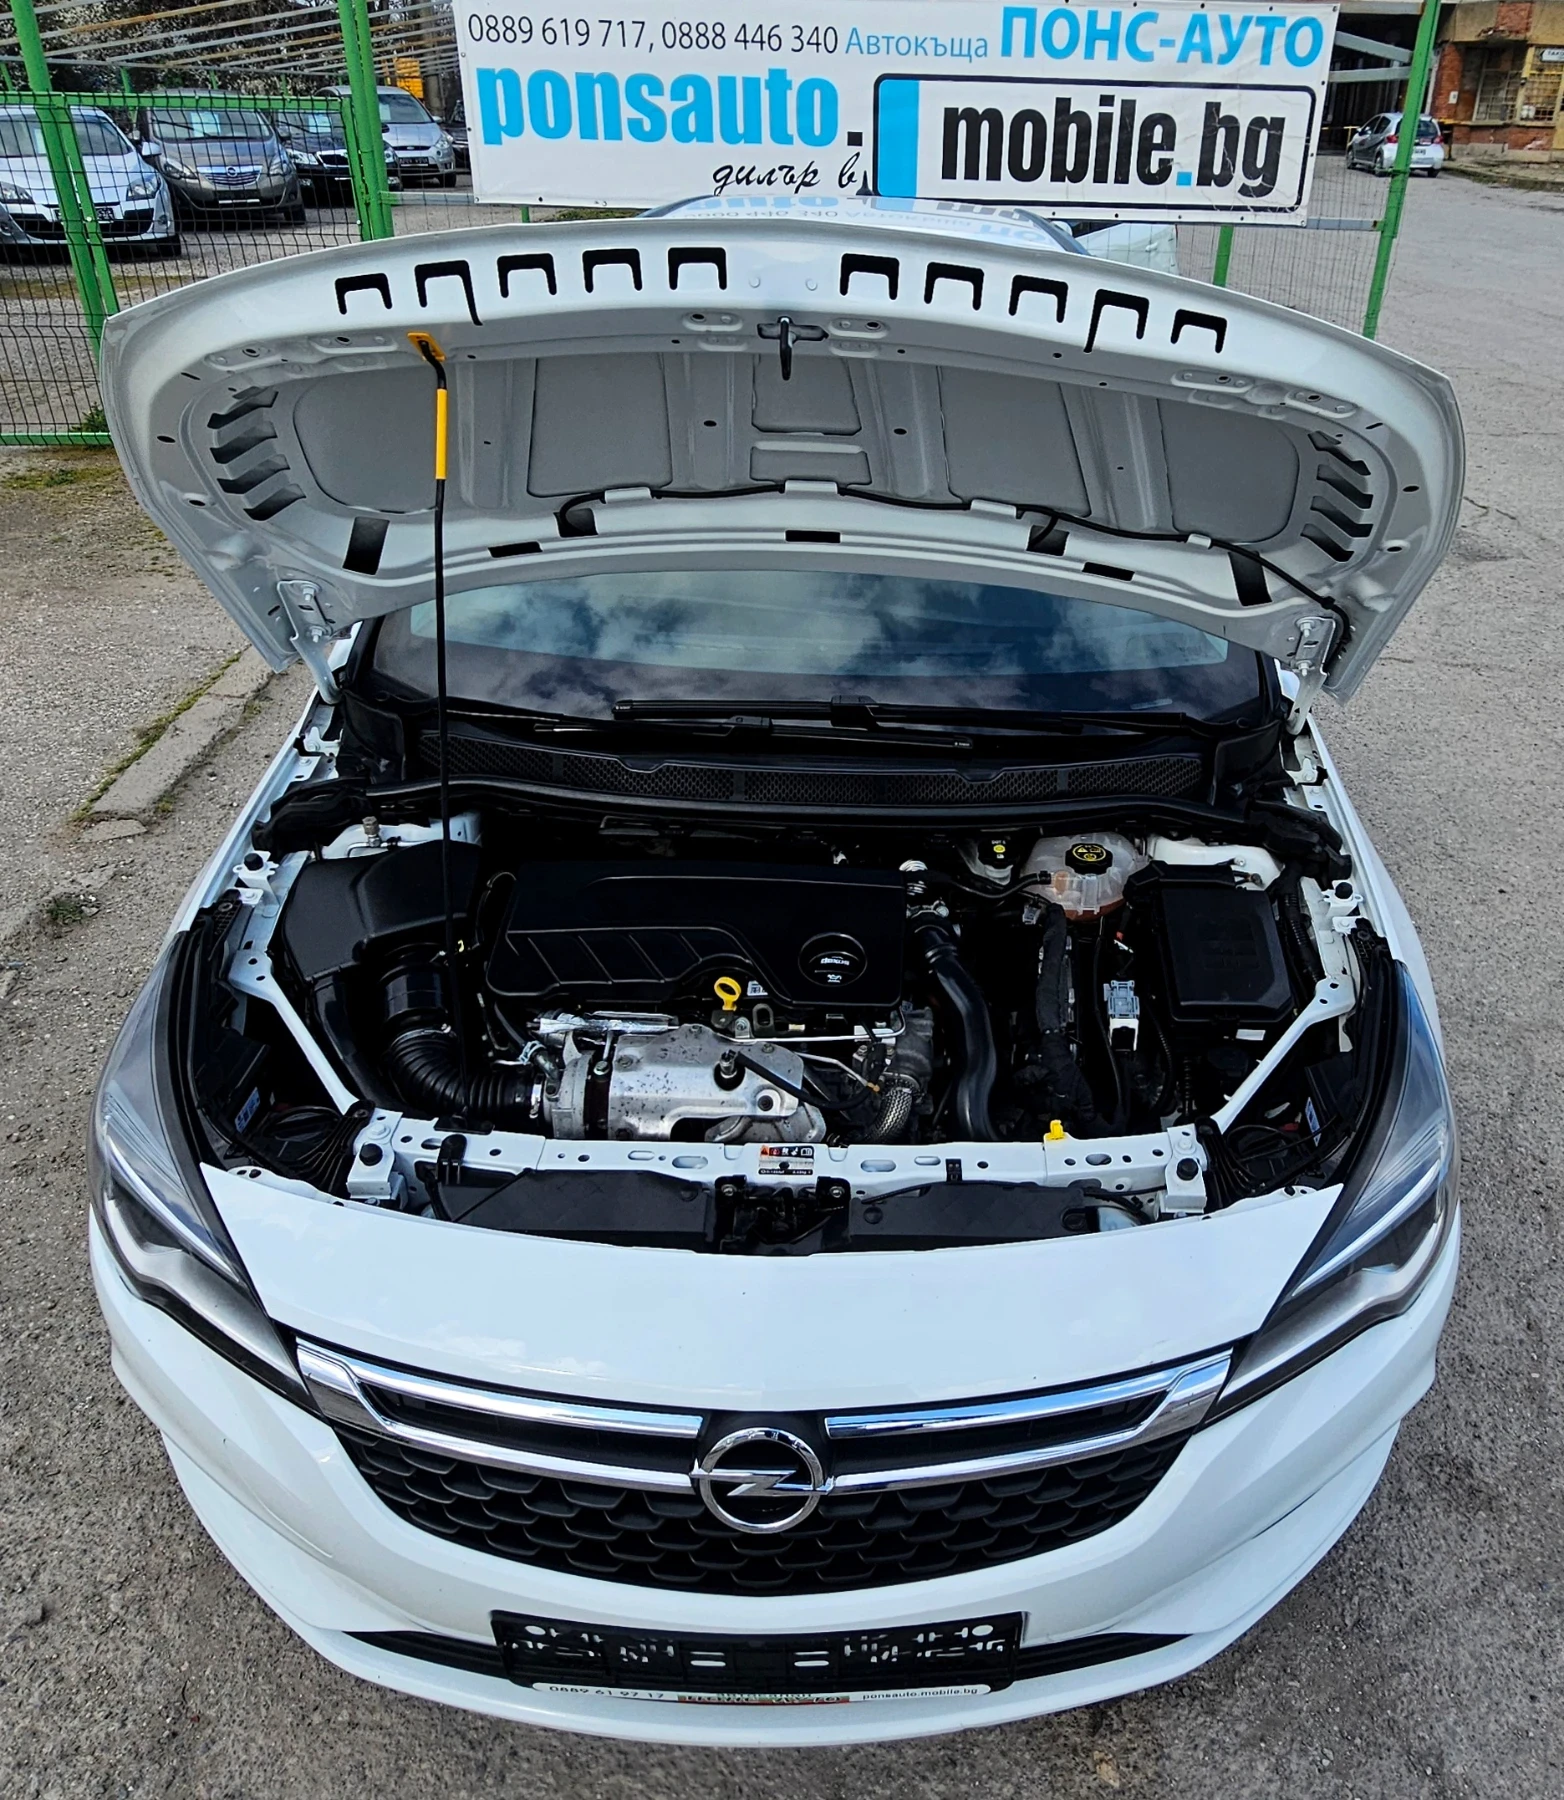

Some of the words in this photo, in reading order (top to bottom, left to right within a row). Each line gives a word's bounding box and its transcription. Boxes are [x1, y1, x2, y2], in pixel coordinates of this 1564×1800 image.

[468, 13, 533, 44] 0889
[542, 17, 590, 46] 619
[598, 19, 654, 53] 717,
[662, 21, 726, 50] 0888
[734, 23, 782, 51] 446
[790, 25, 838, 54] 340
[844, 27, 989, 63] Автокъща
[1000, 6, 1324, 68] ПОНС-АУТО
[941, 94, 1286, 198] mobile.bg
[712, 160, 820, 196] дилър
